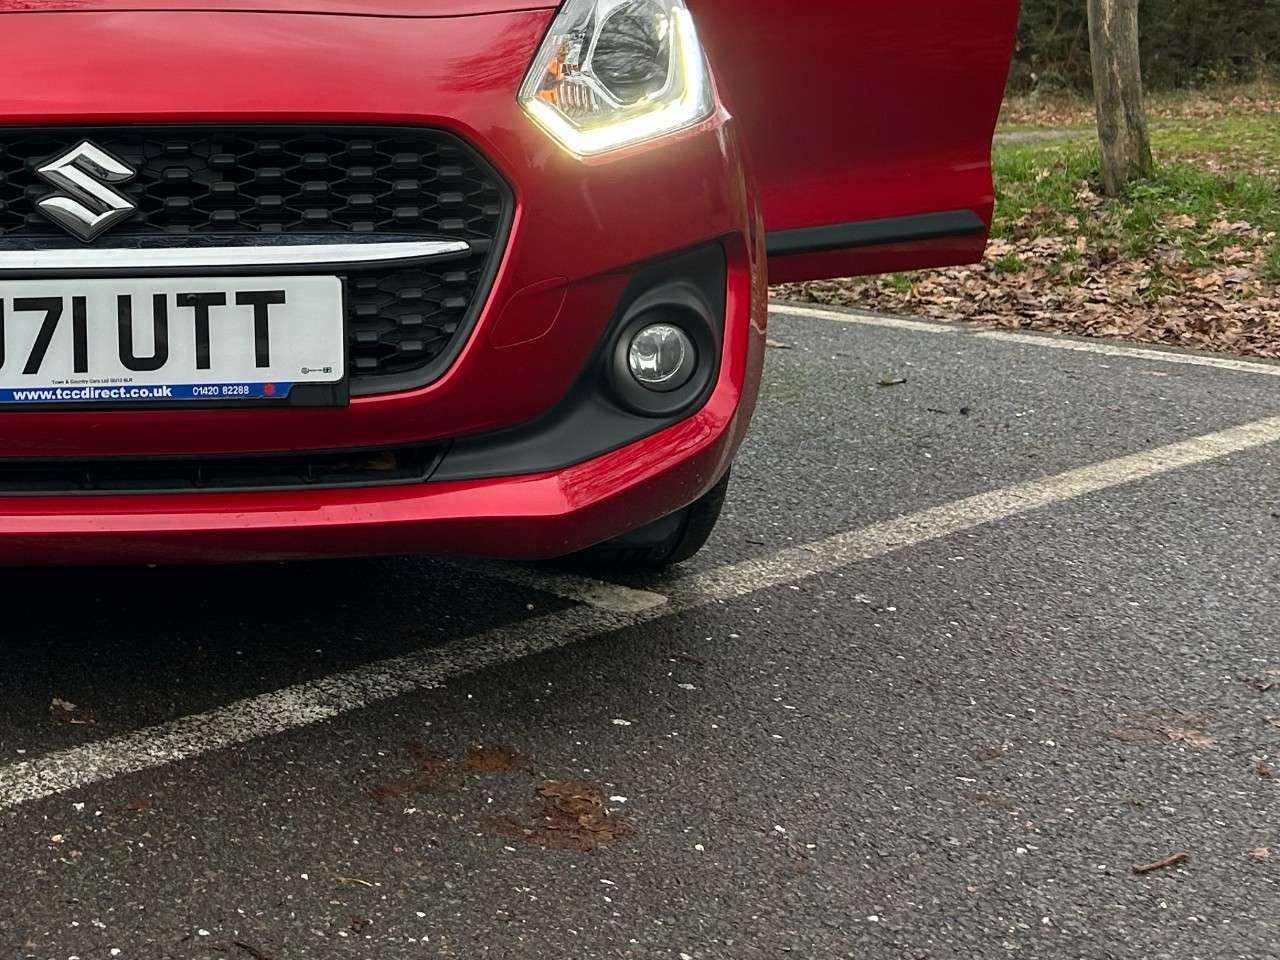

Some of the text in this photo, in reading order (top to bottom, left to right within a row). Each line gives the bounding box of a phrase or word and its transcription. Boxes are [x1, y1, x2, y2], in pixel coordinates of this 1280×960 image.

[118, 290, 286, 371] UTT
[13, 385, 173, 401] www.tccdirect.co.uk
[192, 386, 219, 396] 01420
[222, 385, 250, 395] 82288
